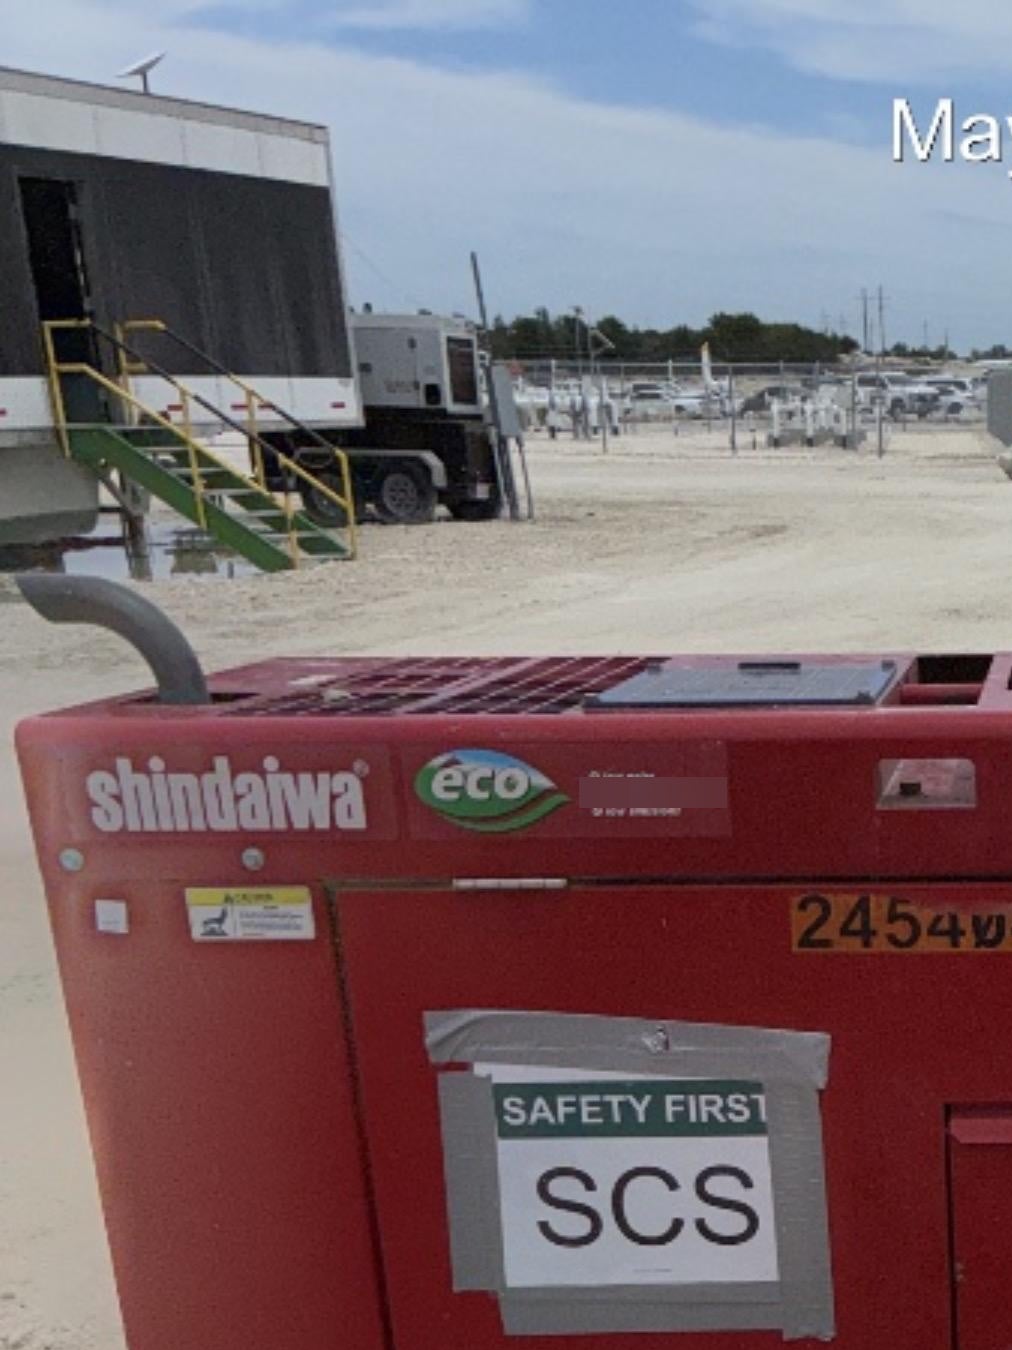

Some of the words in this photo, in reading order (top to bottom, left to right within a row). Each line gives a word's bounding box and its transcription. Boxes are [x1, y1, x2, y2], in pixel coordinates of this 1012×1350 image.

[430, 766, 531, 801] eco
[502, 1093, 651, 1126] SAFETY
[665, 1092, 768, 1124] FIRST
[536, 1164, 760, 1248] SCS
